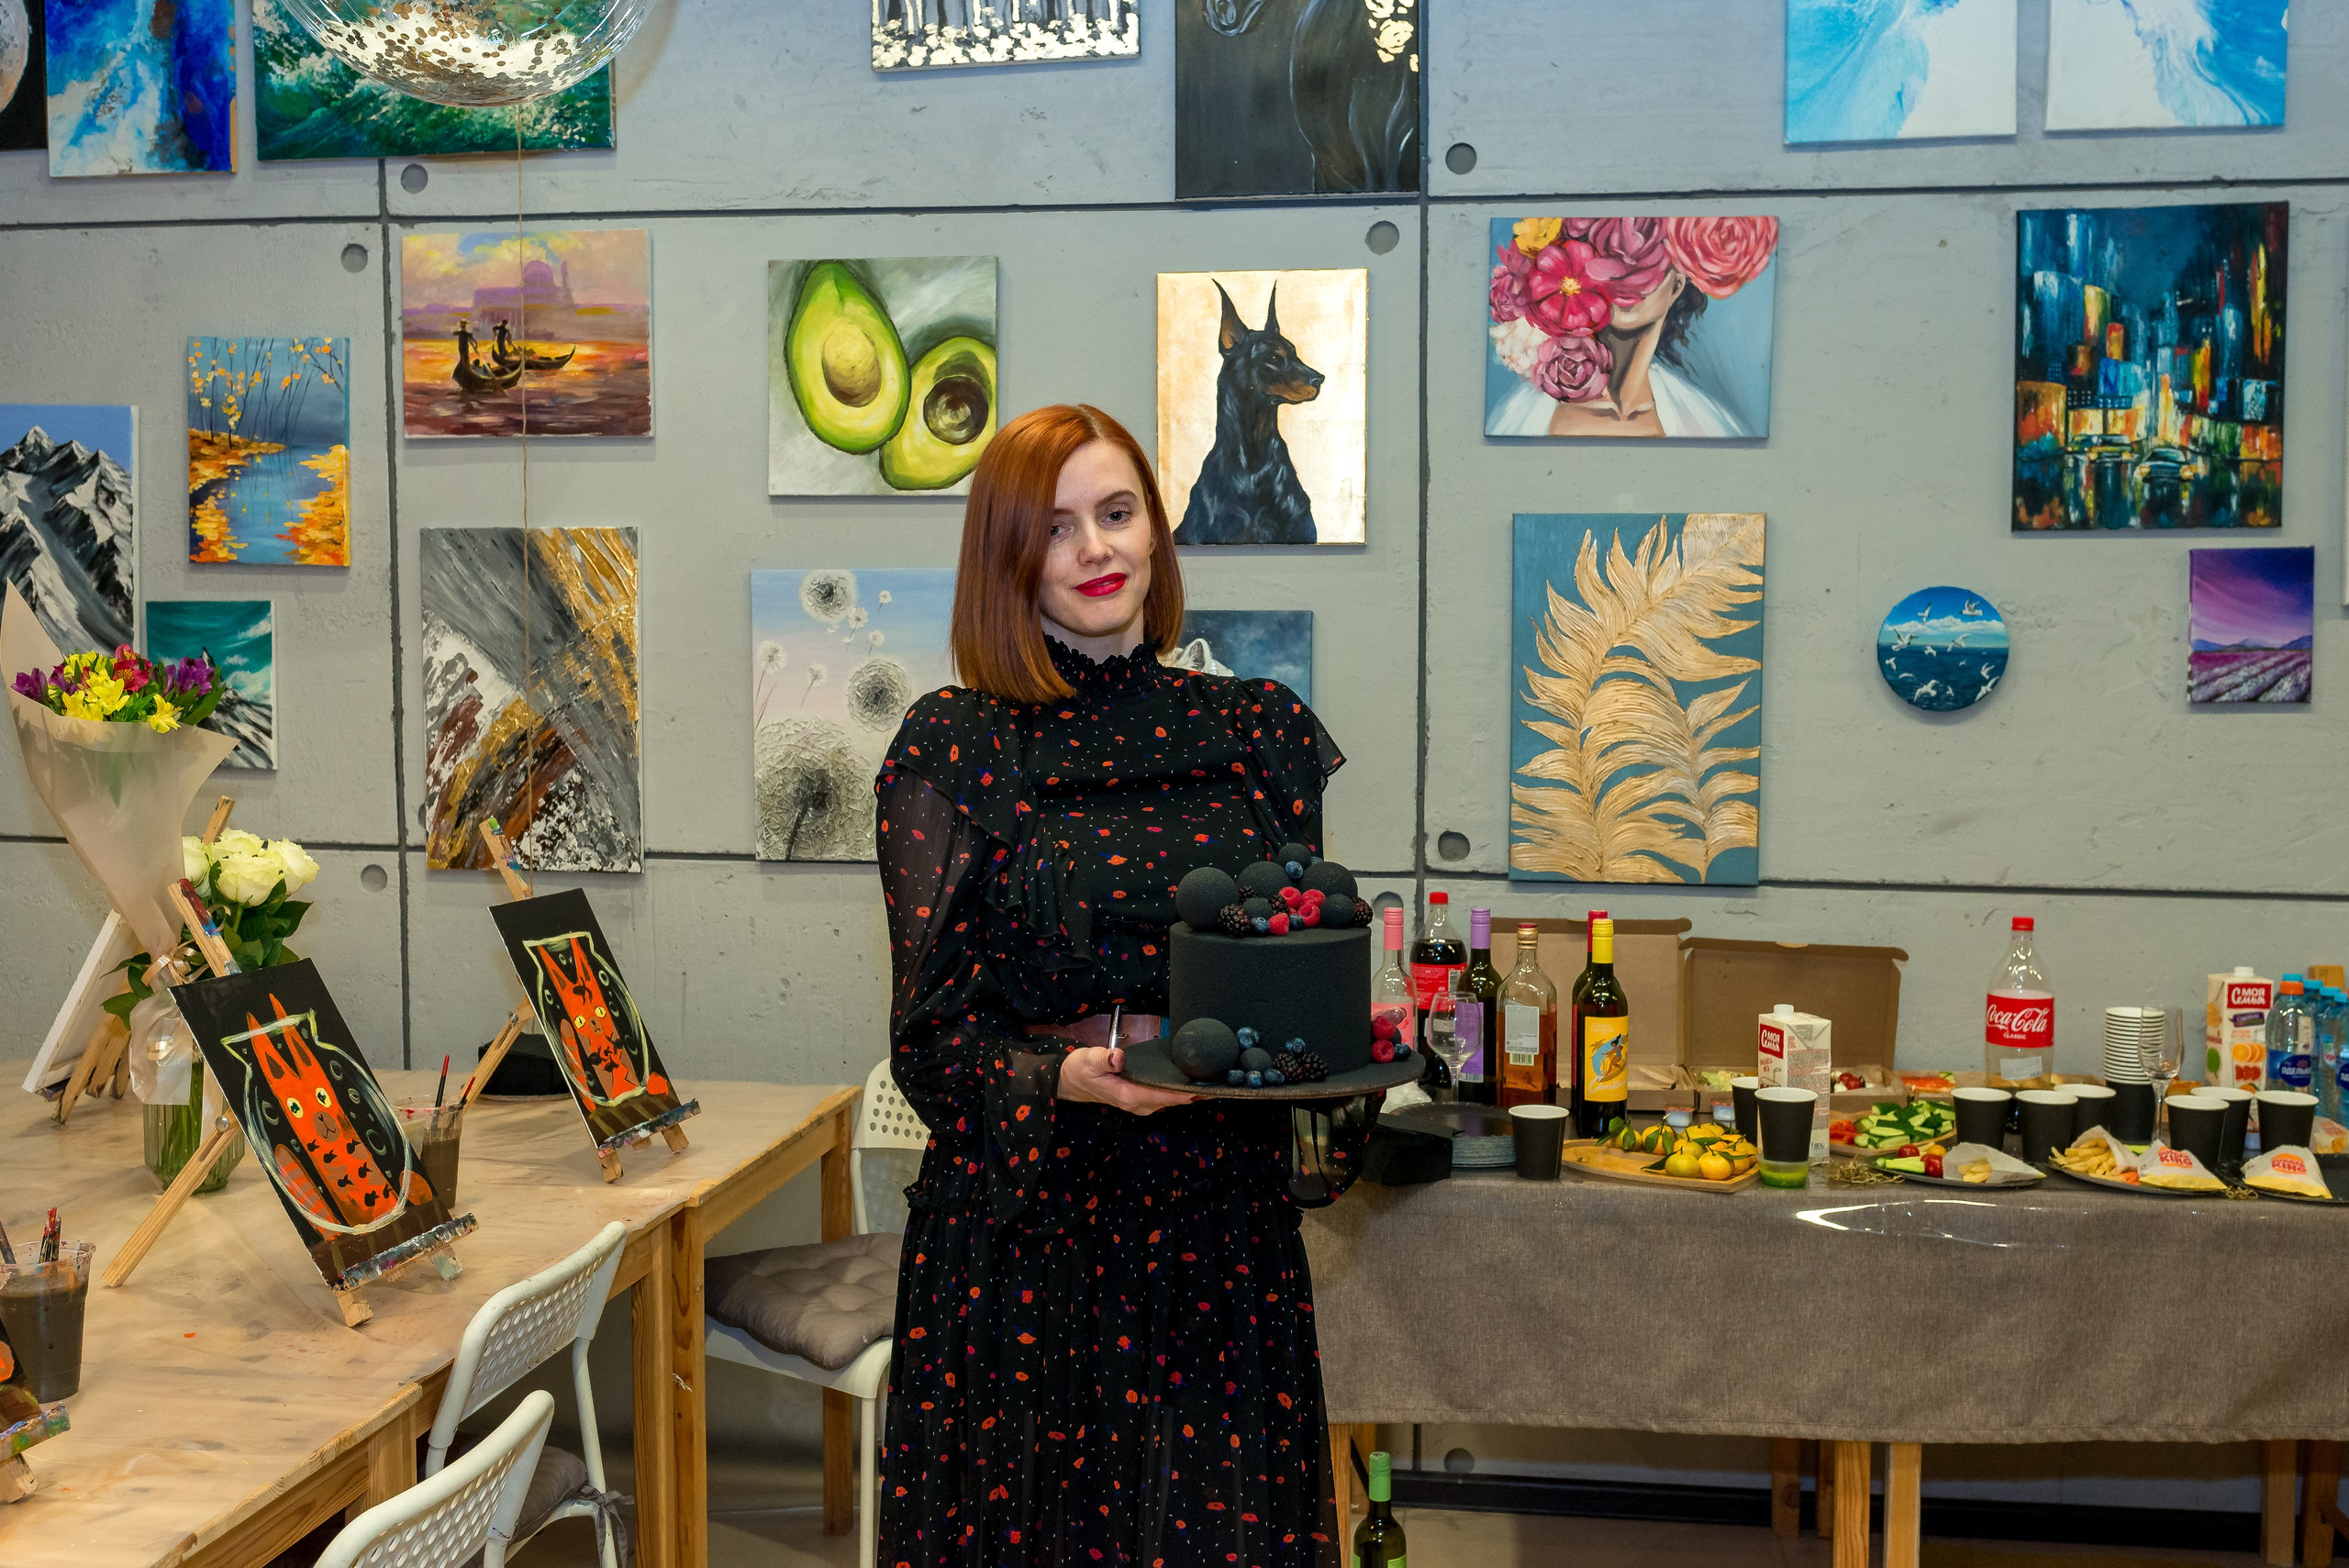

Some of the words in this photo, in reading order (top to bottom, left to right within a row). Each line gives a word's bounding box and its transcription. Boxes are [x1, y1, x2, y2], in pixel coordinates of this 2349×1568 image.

[1987, 1004, 2050, 1033] Coca-Cola
[2159, 1155, 2193, 1169] KING
[2271, 1163, 2307, 1174] KING
